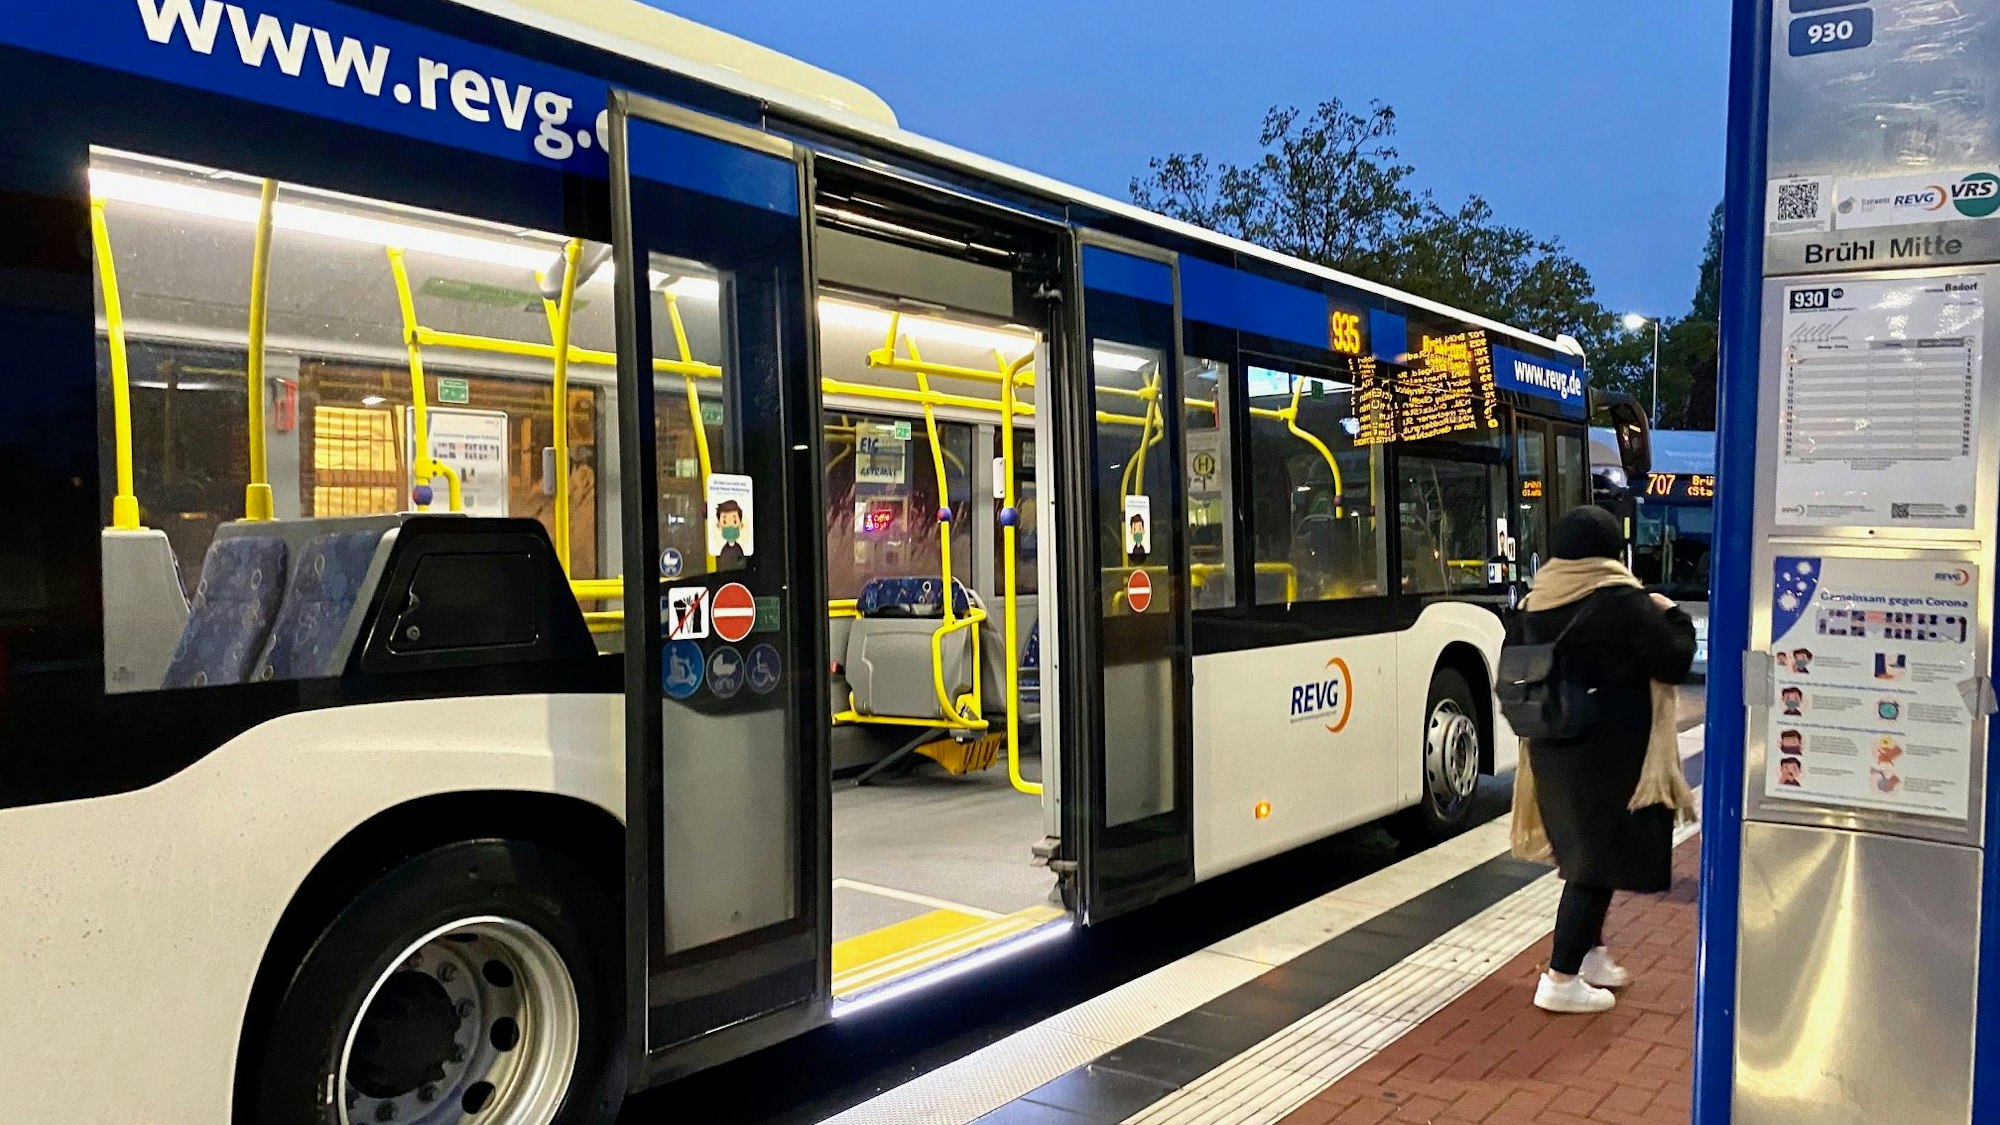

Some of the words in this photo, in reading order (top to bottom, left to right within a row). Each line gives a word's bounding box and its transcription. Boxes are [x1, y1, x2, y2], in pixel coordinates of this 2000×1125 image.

[1808, 20, 1854, 44] 930
[1951, 182, 1993, 199] VRS
[1894, 193, 1935, 206] REVG
[1805, 239, 1875, 264] Brühl
[1890, 236, 1963, 258] Mitte
[1945, 282, 1978, 292] Badorf
[1794, 291, 1824, 308] 930
[1332, 311, 1361, 354] 935
[1514, 360, 1582, 400] www.revg.de
[1646, 474, 1676, 495] 707
[1691, 475, 1715, 486] Brü
[1687, 487, 1714, 497] (Sta
[1821, 592, 1886, 605] Gemeinsam
[1889, 596, 1924, 608] gegen
[1926, 597, 1969, 608] Corona
[1291, 679, 1339, 716] REVG
